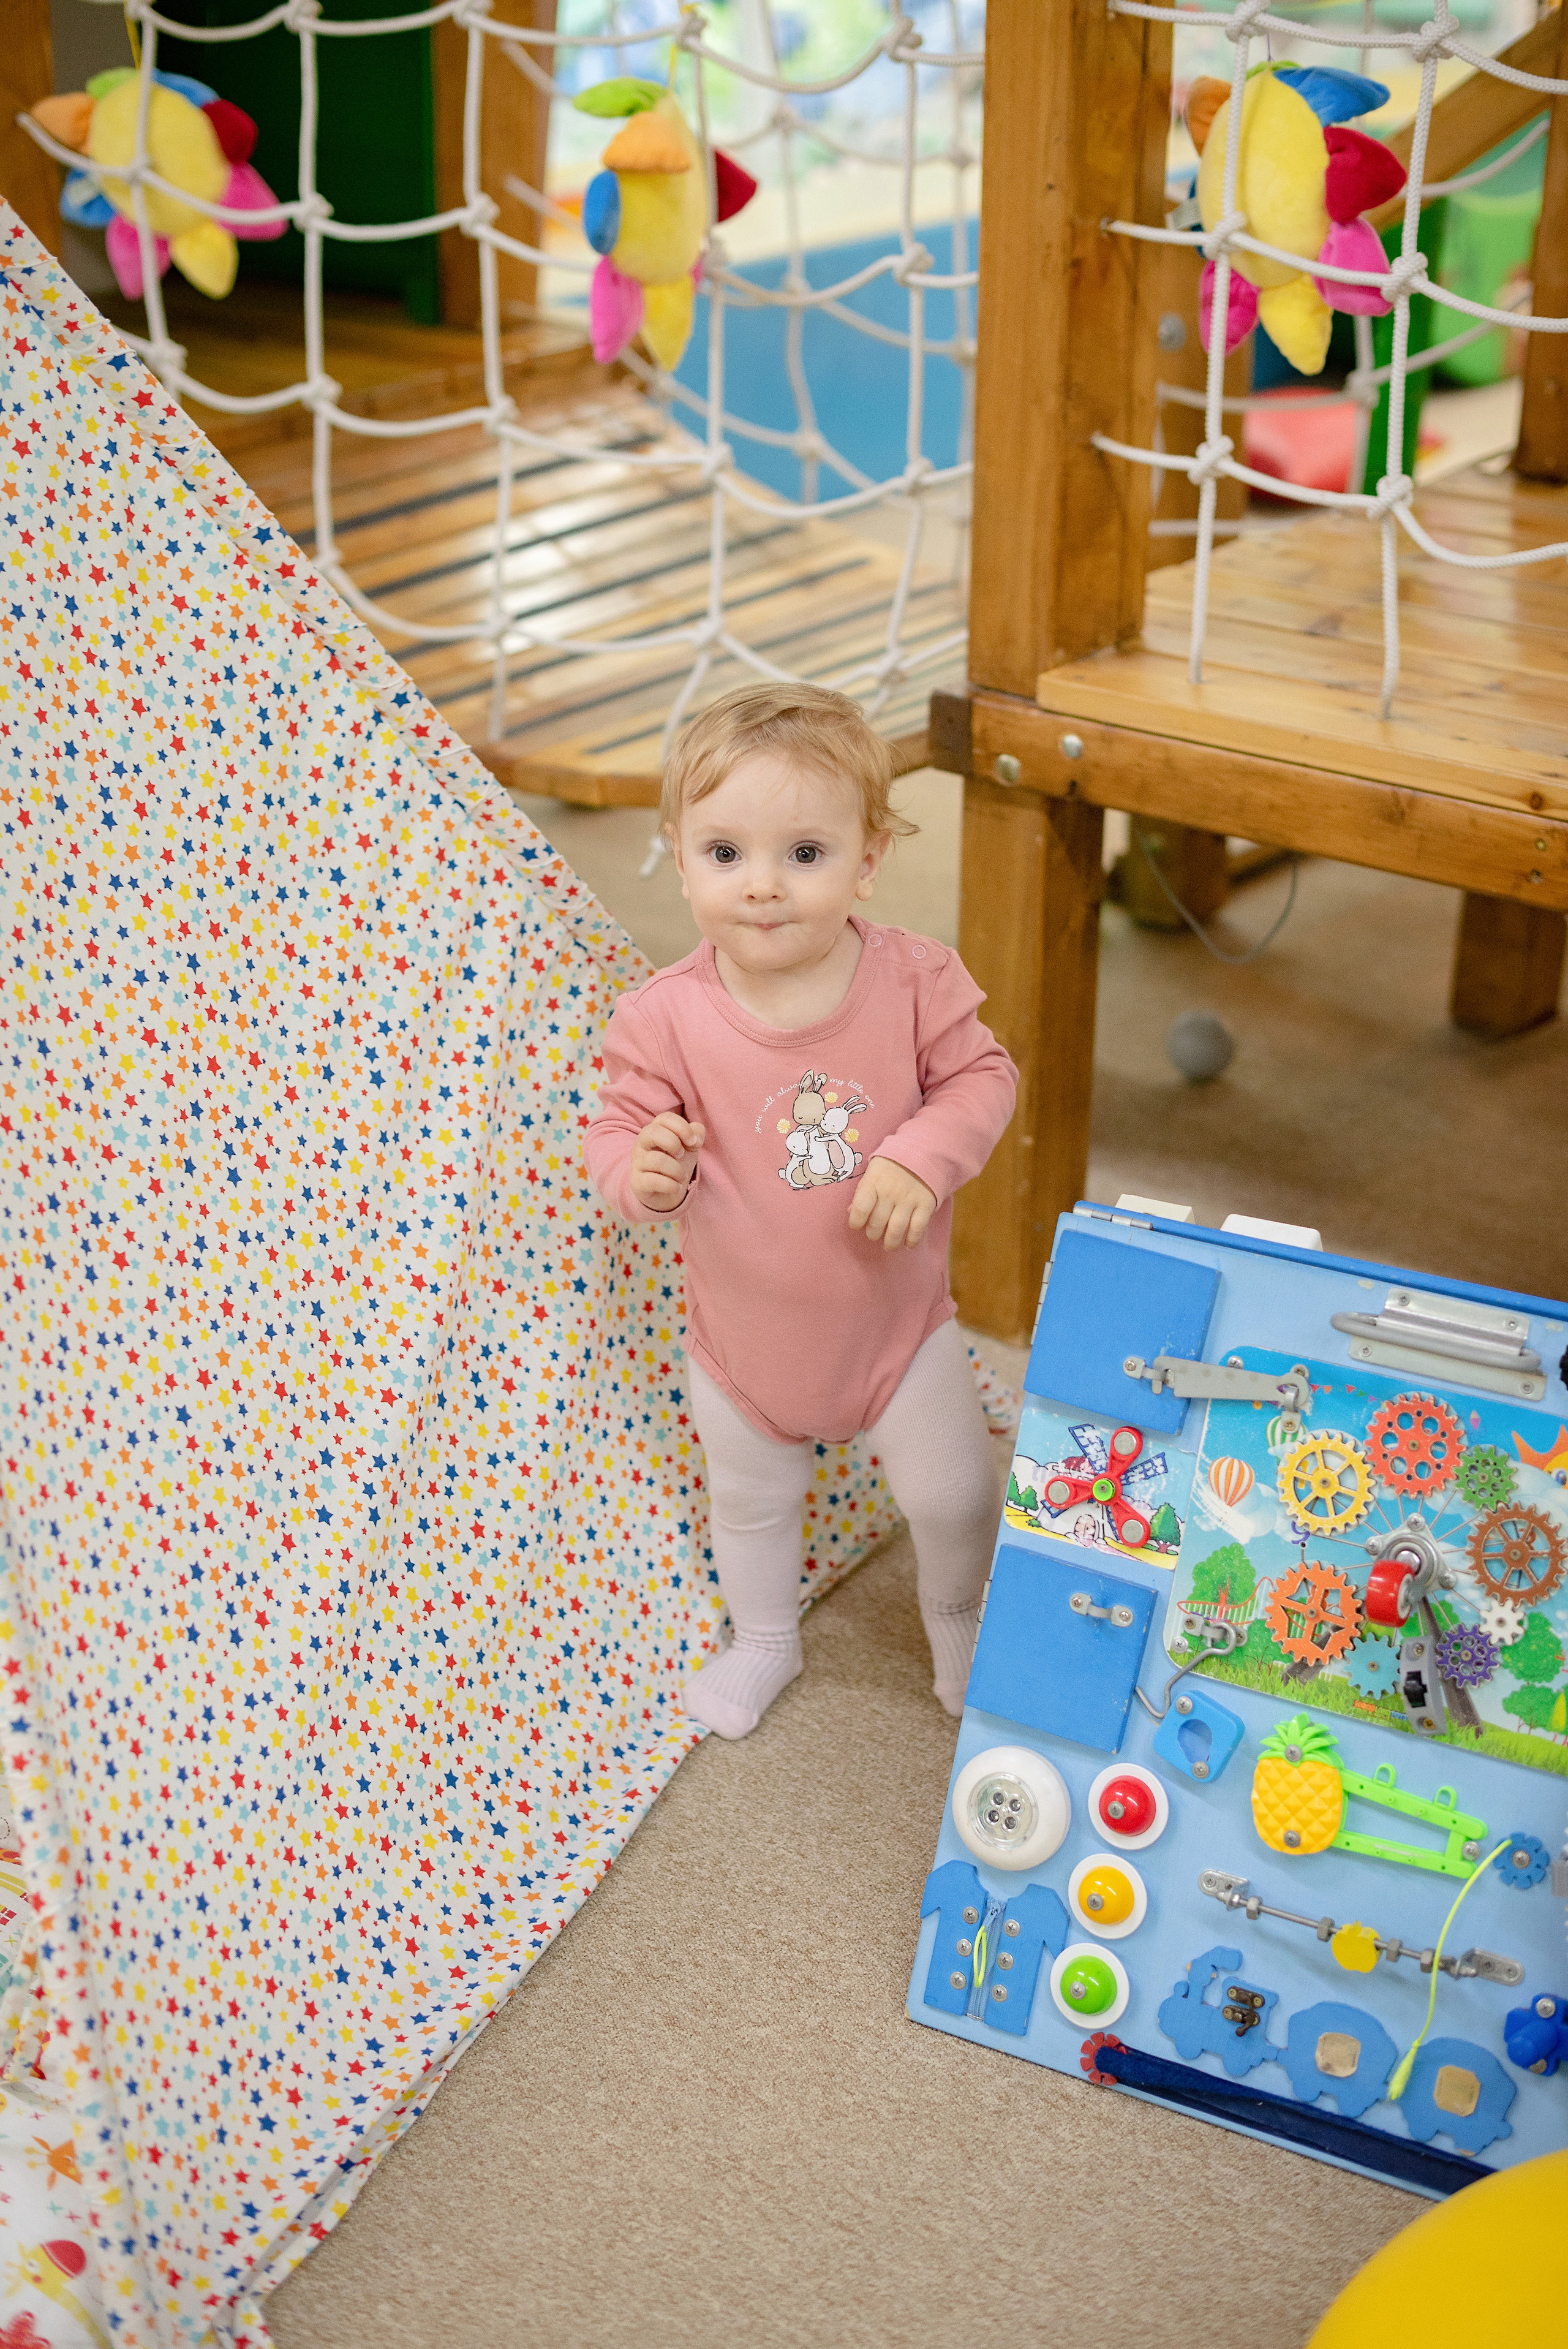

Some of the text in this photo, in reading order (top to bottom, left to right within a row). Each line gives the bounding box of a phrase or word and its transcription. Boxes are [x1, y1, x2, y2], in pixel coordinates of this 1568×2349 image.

[754, 1114, 763, 1134] you
[761, 1095, 775, 1113] will
[848, 1079, 864, 1094] little
[864, 1094, 875, 1109] one
